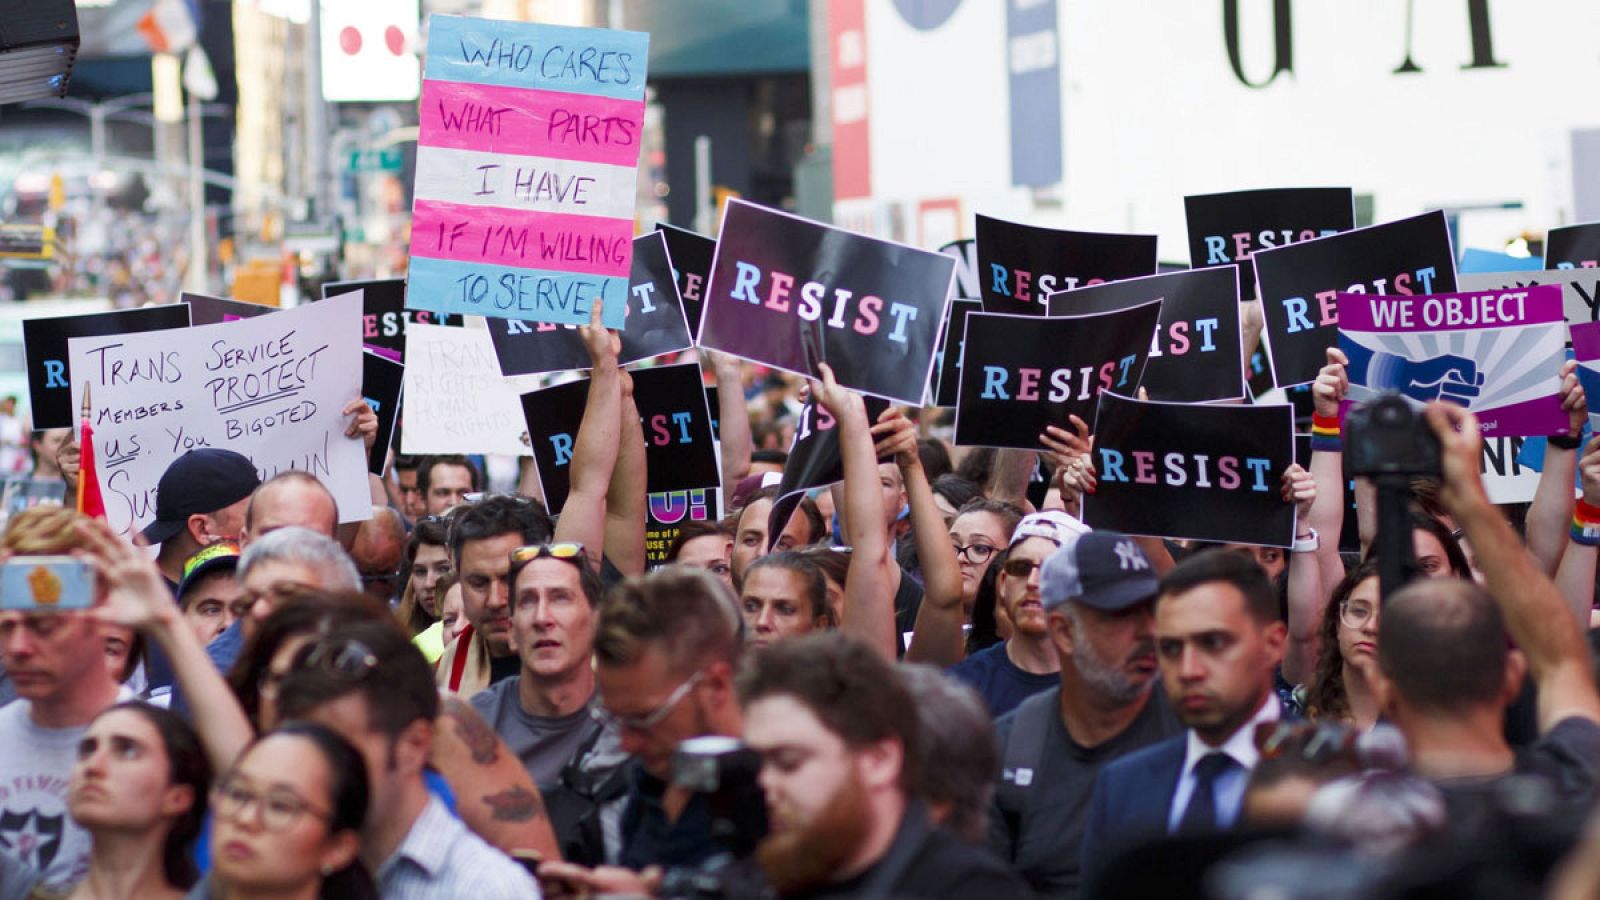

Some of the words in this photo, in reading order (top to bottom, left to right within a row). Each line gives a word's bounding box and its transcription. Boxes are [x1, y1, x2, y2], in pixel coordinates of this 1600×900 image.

[460, 38, 532, 72] WHO
[541, 45, 632, 85] CARES
[439, 99, 513, 135] WHAT
[547, 108, 635, 146] PARTS
[473, 164, 501, 196] I
[514, 167, 596, 204] HAVE
[437, 222, 469, 252] IF
[481, 224, 529, 258] I'M
[540, 231, 627, 267] WILLING
[456, 273, 489, 304] TO
[494, 273, 611, 317] SERVE!
[730, 260, 918, 343] RESIST
[1370, 299, 1414, 328] WE
[1423, 292, 1529, 327] OBJECT
[86, 343, 182, 386] TRANS
[205, 330, 296, 371] SERVICE
[425, 339, 494, 372] TRAN
[981, 353, 1137, 402] RESIST
[97, 399, 184, 425] MEMBERS
[204, 344, 329, 408] PROTECT
[226, 400, 317, 440] BIGOTED
[1100, 447, 1271, 492] RESIST
